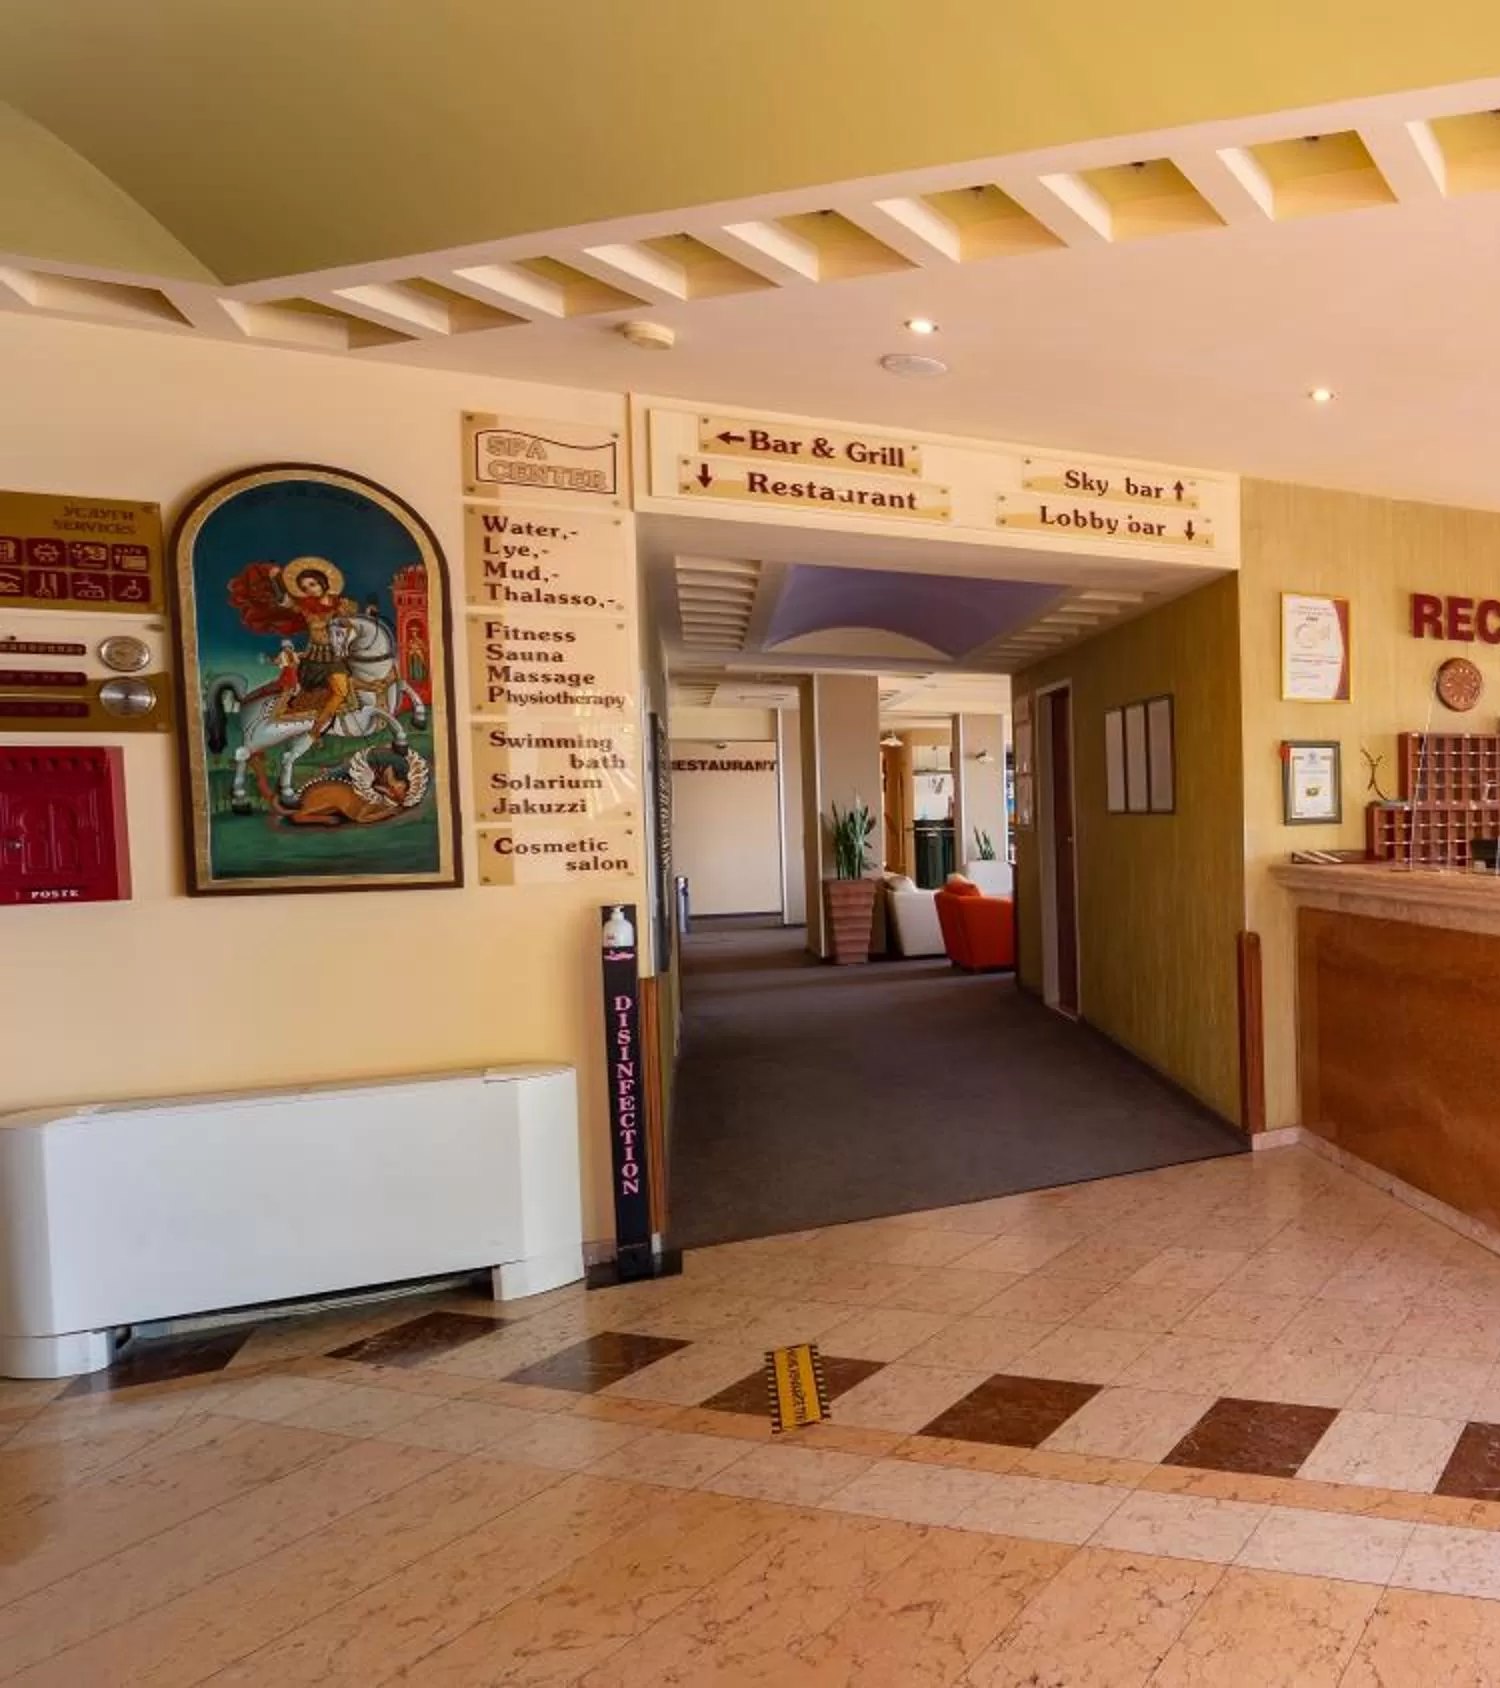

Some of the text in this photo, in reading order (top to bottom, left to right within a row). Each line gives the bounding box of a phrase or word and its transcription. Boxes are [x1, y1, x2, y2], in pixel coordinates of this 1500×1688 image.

[486, 435, 548, 461] SPA
[749, 430, 905, 468] Bar & Grill
[487, 459, 608, 490] CENTER
[1065, 469, 1164, 498] Sky bar
[747, 472, 917, 510] Restaurant
[1040, 505, 1119, 534] Lobby
[485, 621, 576, 643] Fitness
[486, 643, 564, 663] Sauna
[487, 665, 596, 687] Massage
[488, 685, 625, 710] Physiotherapy
[490, 731, 613, 751] Swimming
[568, 754, 626, 770] bath
[490, 773, 603, 789] Solarium
[492, 797, 587, 815] Jakuzzi
[493, 837, 609, 855] Cosmetic
[565, 855, 629, 872] salon
[614, 995, 639, 1196] DISINFECTION
